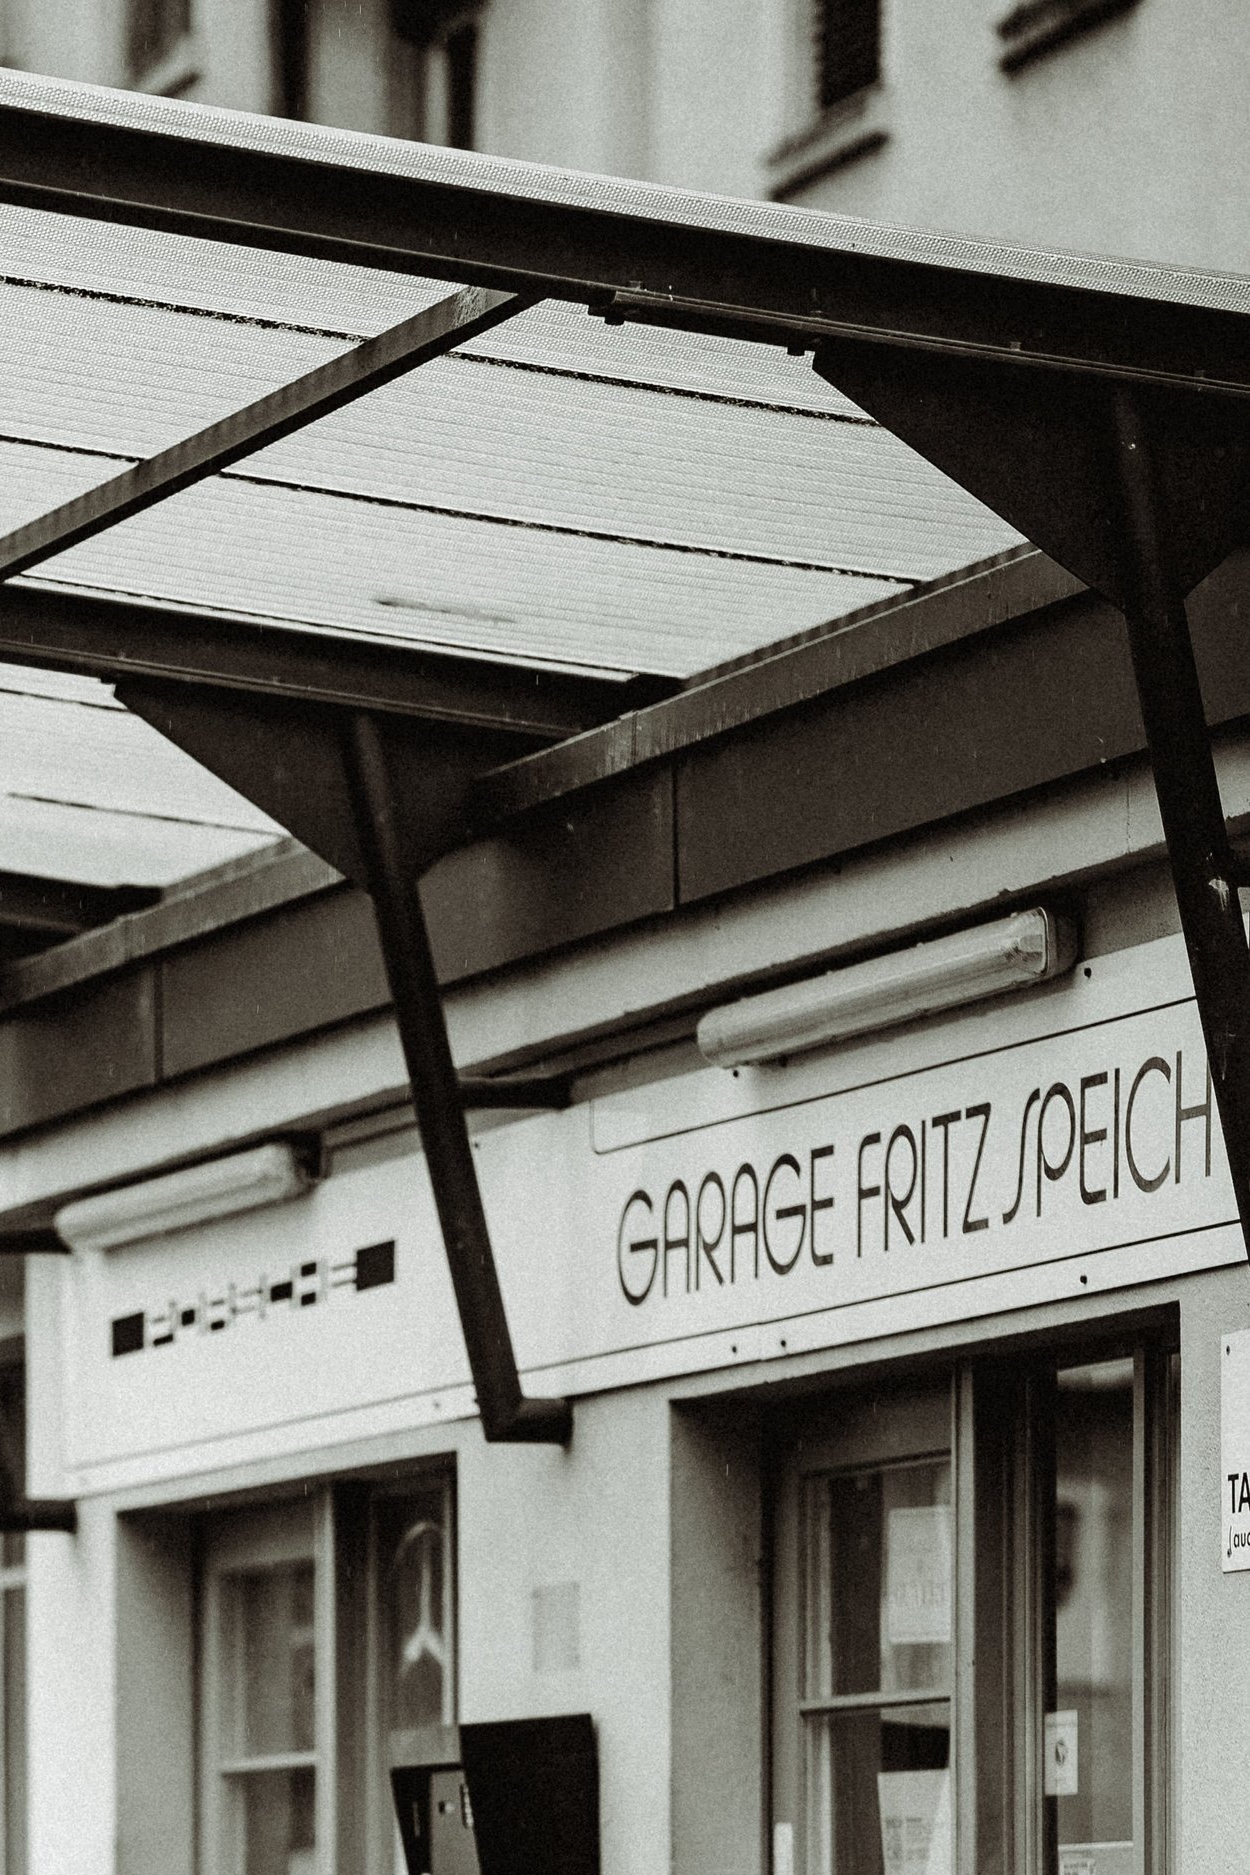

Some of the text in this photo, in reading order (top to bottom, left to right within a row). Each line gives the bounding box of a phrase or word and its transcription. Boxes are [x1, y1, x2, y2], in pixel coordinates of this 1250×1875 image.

[618, 1144, 835, 1307] GARAGE
[857, 1101, 993, 1258] FRITZ
[1228, 1472, 1250, 1513] TA
